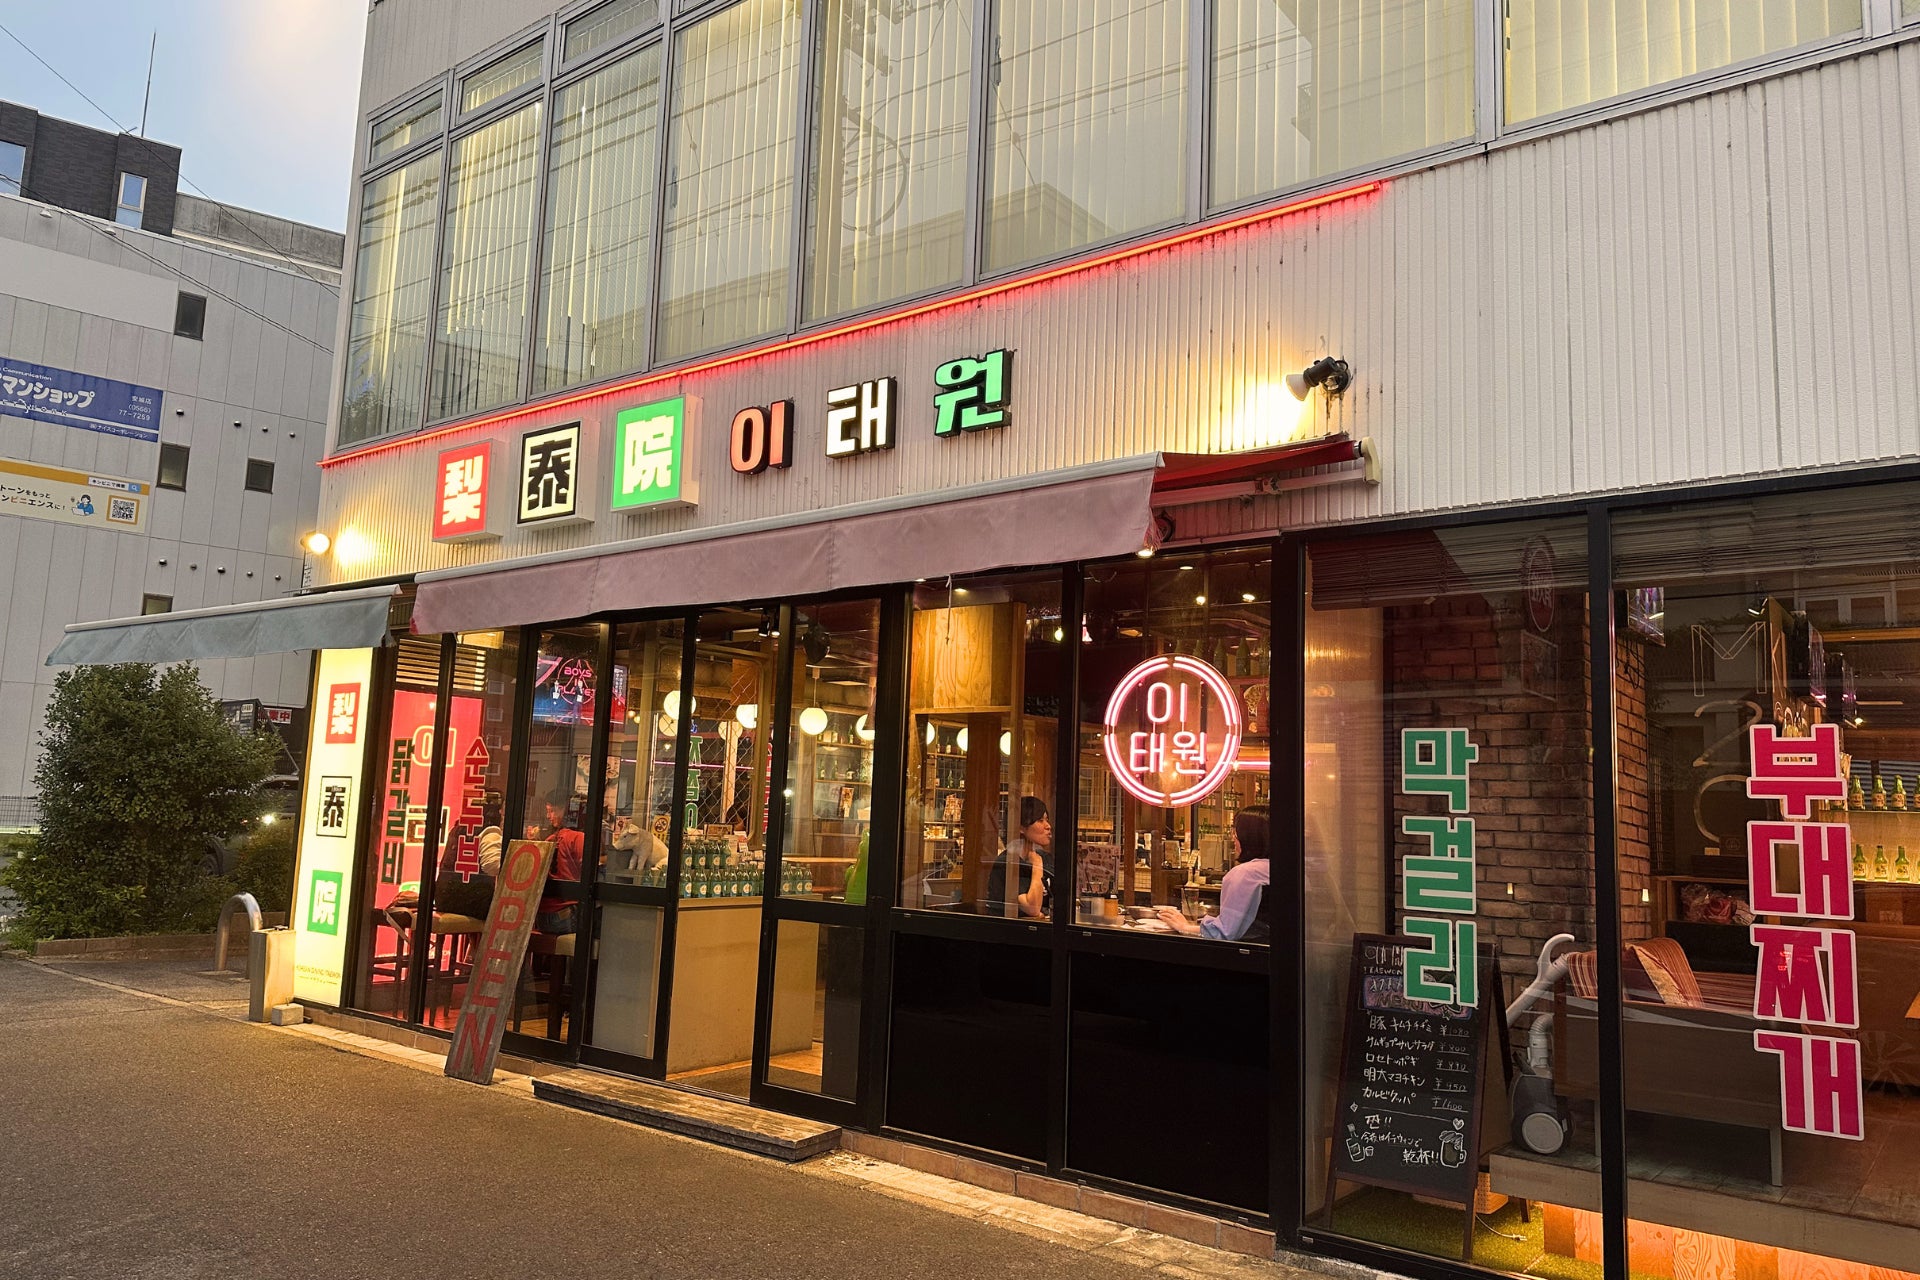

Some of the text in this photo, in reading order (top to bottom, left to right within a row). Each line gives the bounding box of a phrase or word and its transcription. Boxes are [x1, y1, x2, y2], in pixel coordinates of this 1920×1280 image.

[0, 373, 95, 408] マンショップ
[729, 349, 1012, 475] 이태원
[454, 736, 490, 884] 순두부
[1401, 727, 1479, 1008] 막걸리
[453, 843, 542, 1077] OPEN
[1746, 724, 1865, 1141] 부대찌개
